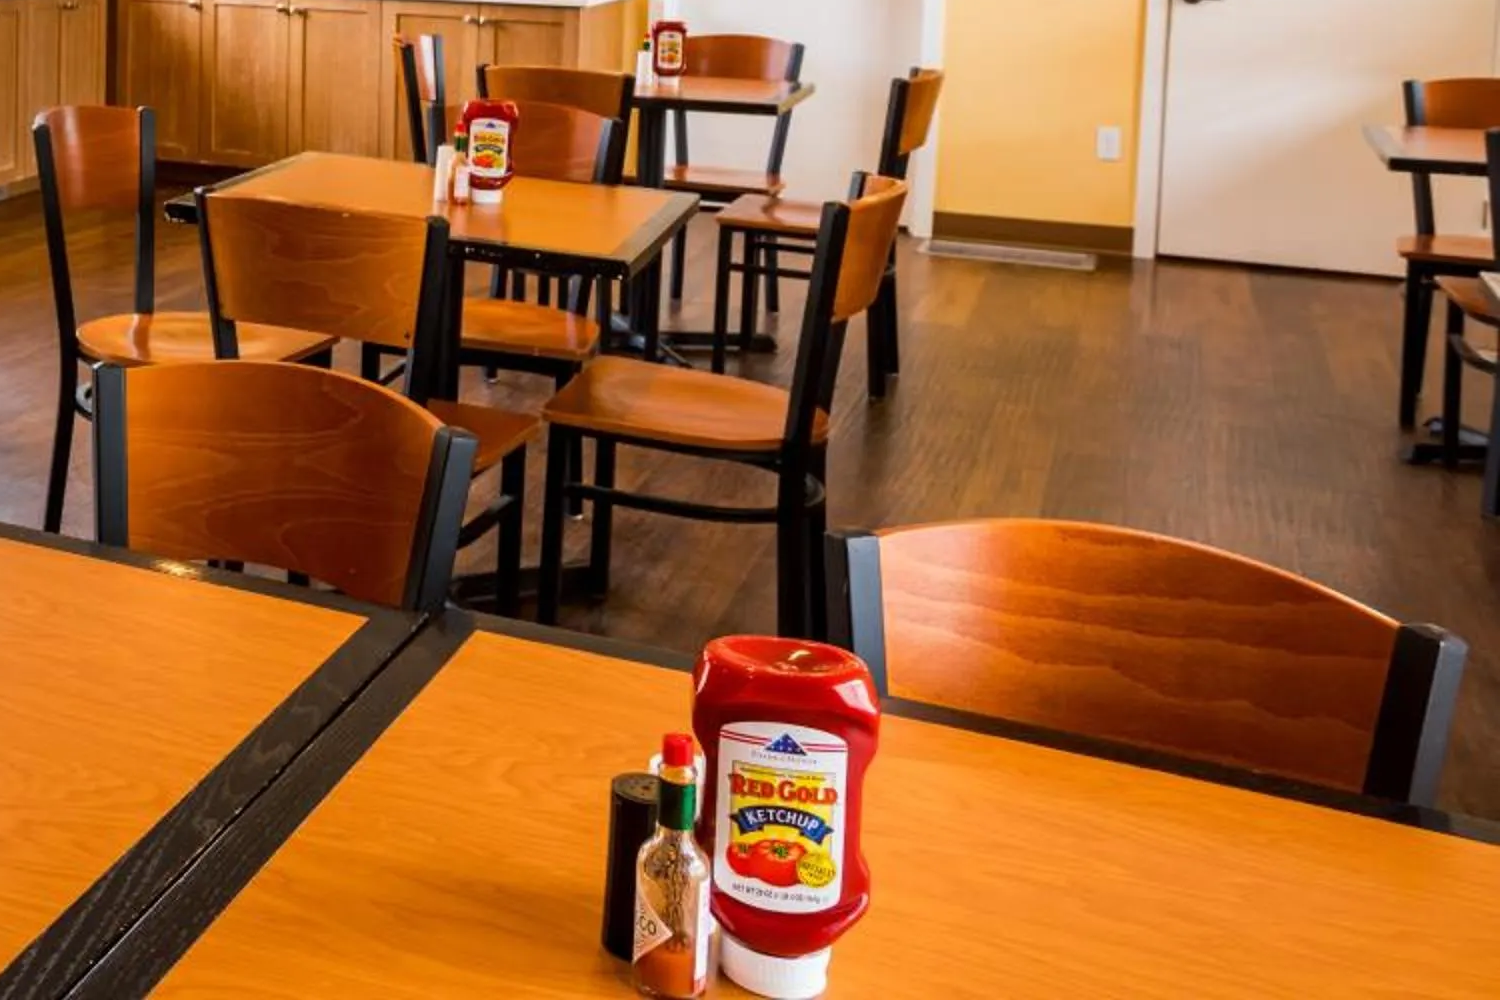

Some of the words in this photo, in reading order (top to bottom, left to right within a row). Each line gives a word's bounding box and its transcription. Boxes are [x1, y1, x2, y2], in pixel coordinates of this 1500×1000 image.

[728, 773, 774, 799] RED
[778, 780, 838, 805] GOLD
[744, 808, 819, 831] KETCHUP
